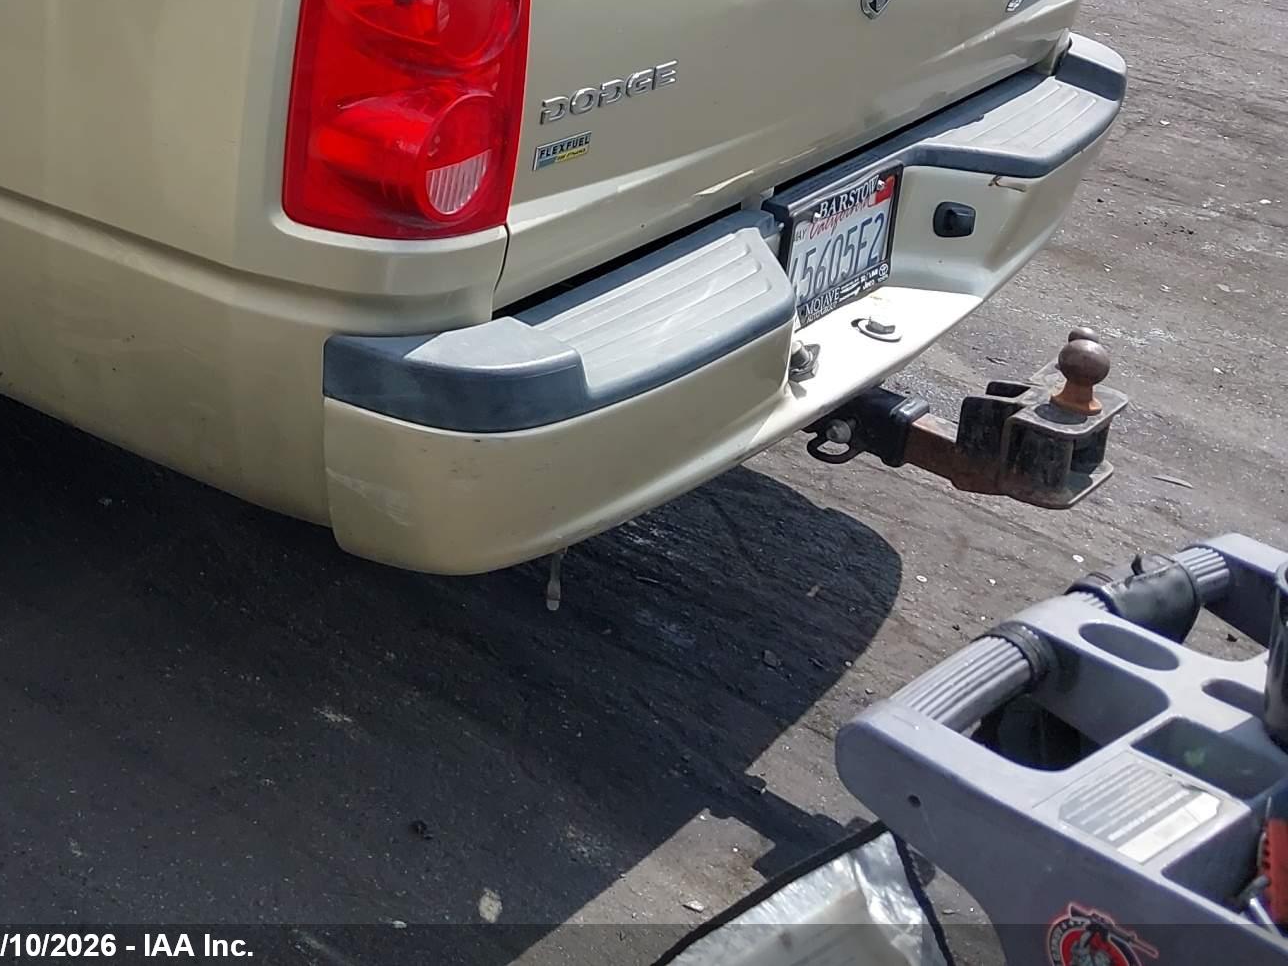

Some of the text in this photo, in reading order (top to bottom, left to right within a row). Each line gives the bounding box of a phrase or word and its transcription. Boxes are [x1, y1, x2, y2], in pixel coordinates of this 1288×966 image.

[539, 58, 678, 125] DODGE
[820, 174, 880, 219] BARSTOW
[805, 286, 841, 315] MOJAVE
